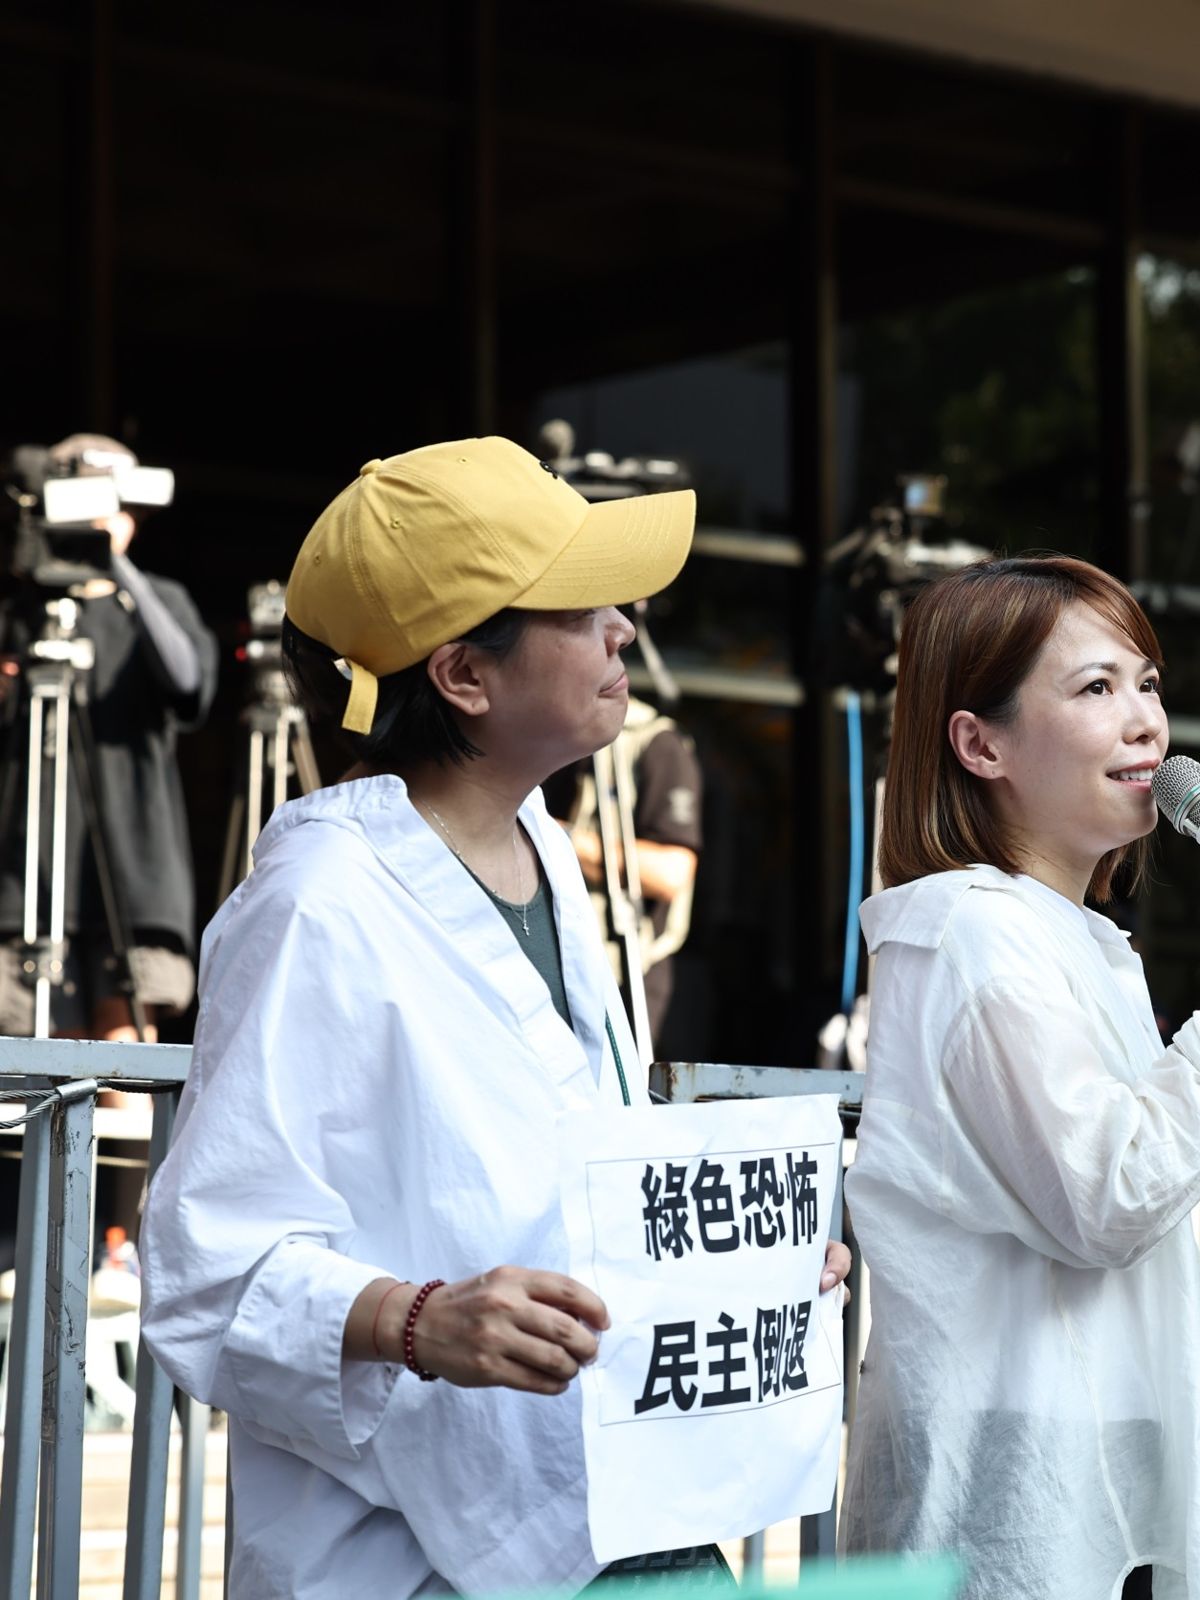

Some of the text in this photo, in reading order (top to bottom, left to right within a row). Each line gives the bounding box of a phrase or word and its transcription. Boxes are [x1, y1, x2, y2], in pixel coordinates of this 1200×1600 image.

[640, 1151, 818, 1261] 綠色恐怖
[634, 1300, 812, 1415] 民主倒退
